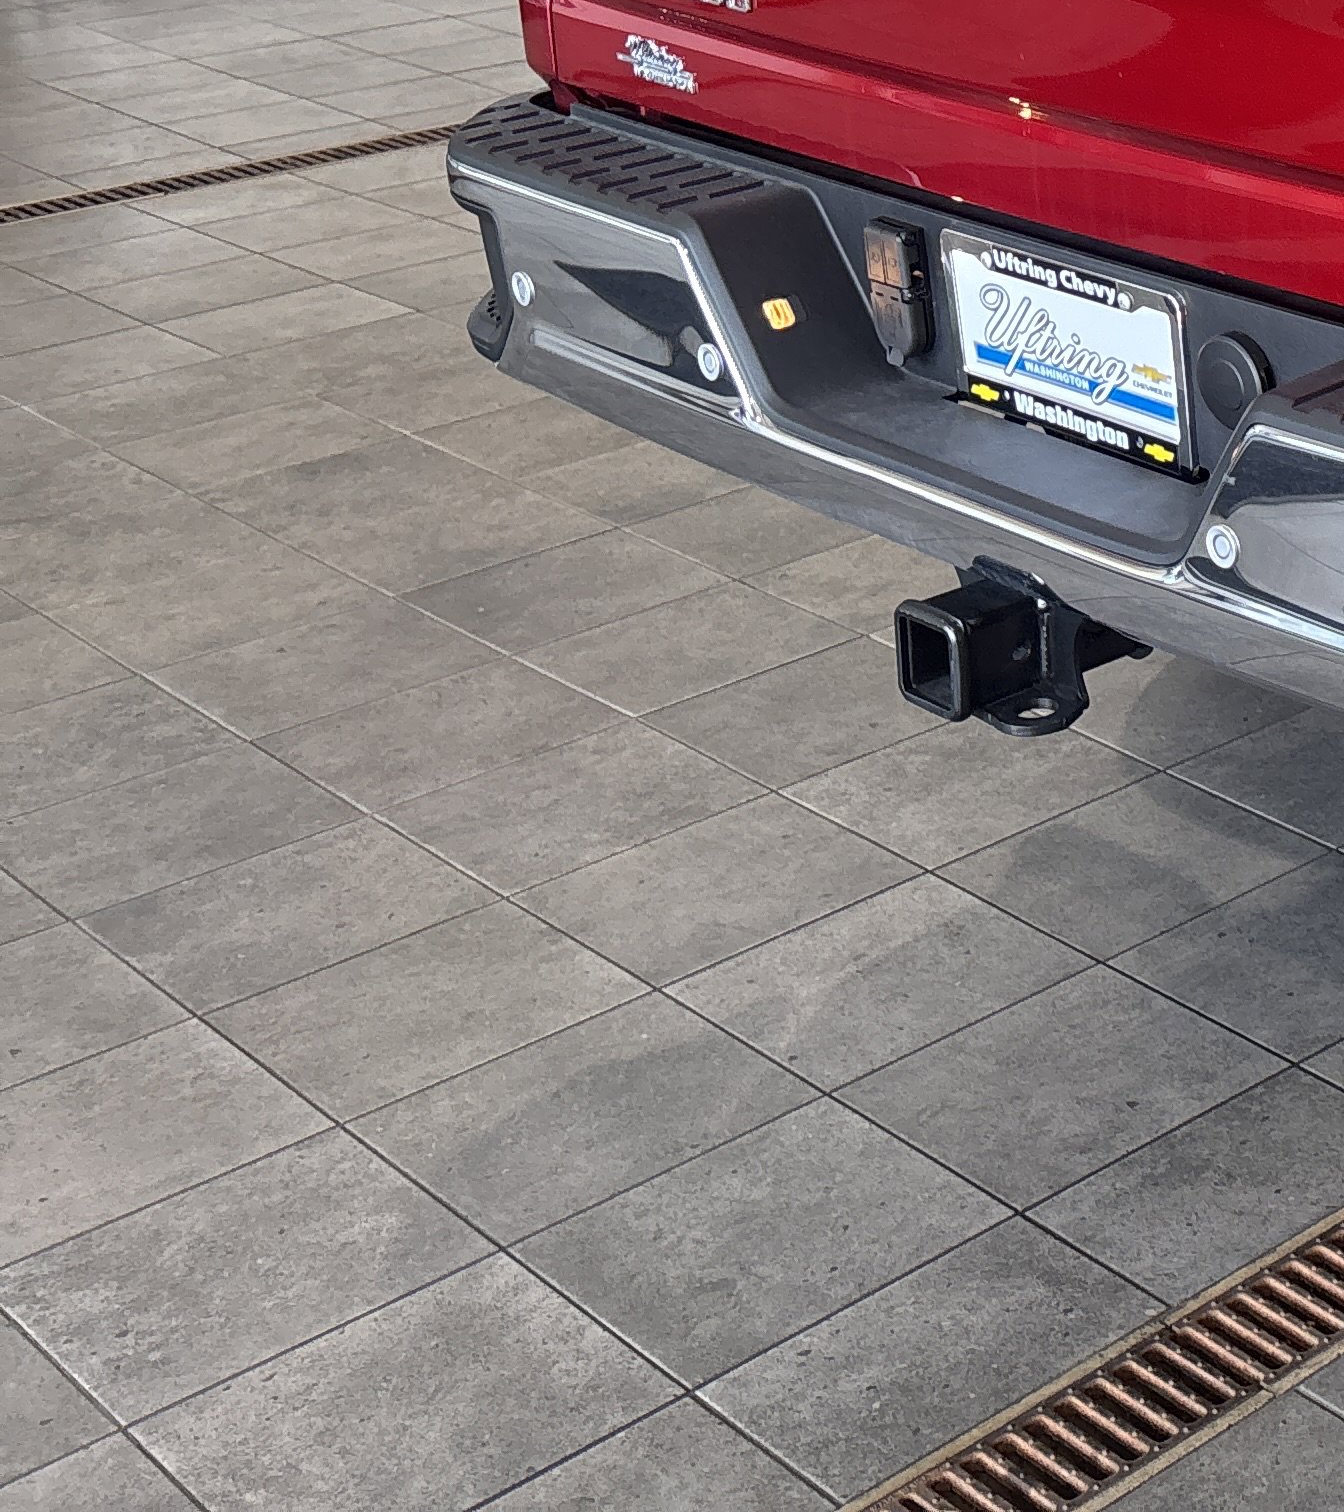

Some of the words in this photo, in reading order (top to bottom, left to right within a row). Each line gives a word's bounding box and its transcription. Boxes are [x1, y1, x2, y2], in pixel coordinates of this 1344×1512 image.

[992, 249, 1058, 288] Uftring
[1059, 270, 1116, 306] Chevy
[979, 282, 1129, 405] Uftring
[1023, 360, 1090, 393] WASHINGTON
[1013, 390, 1130, 451] Washington
